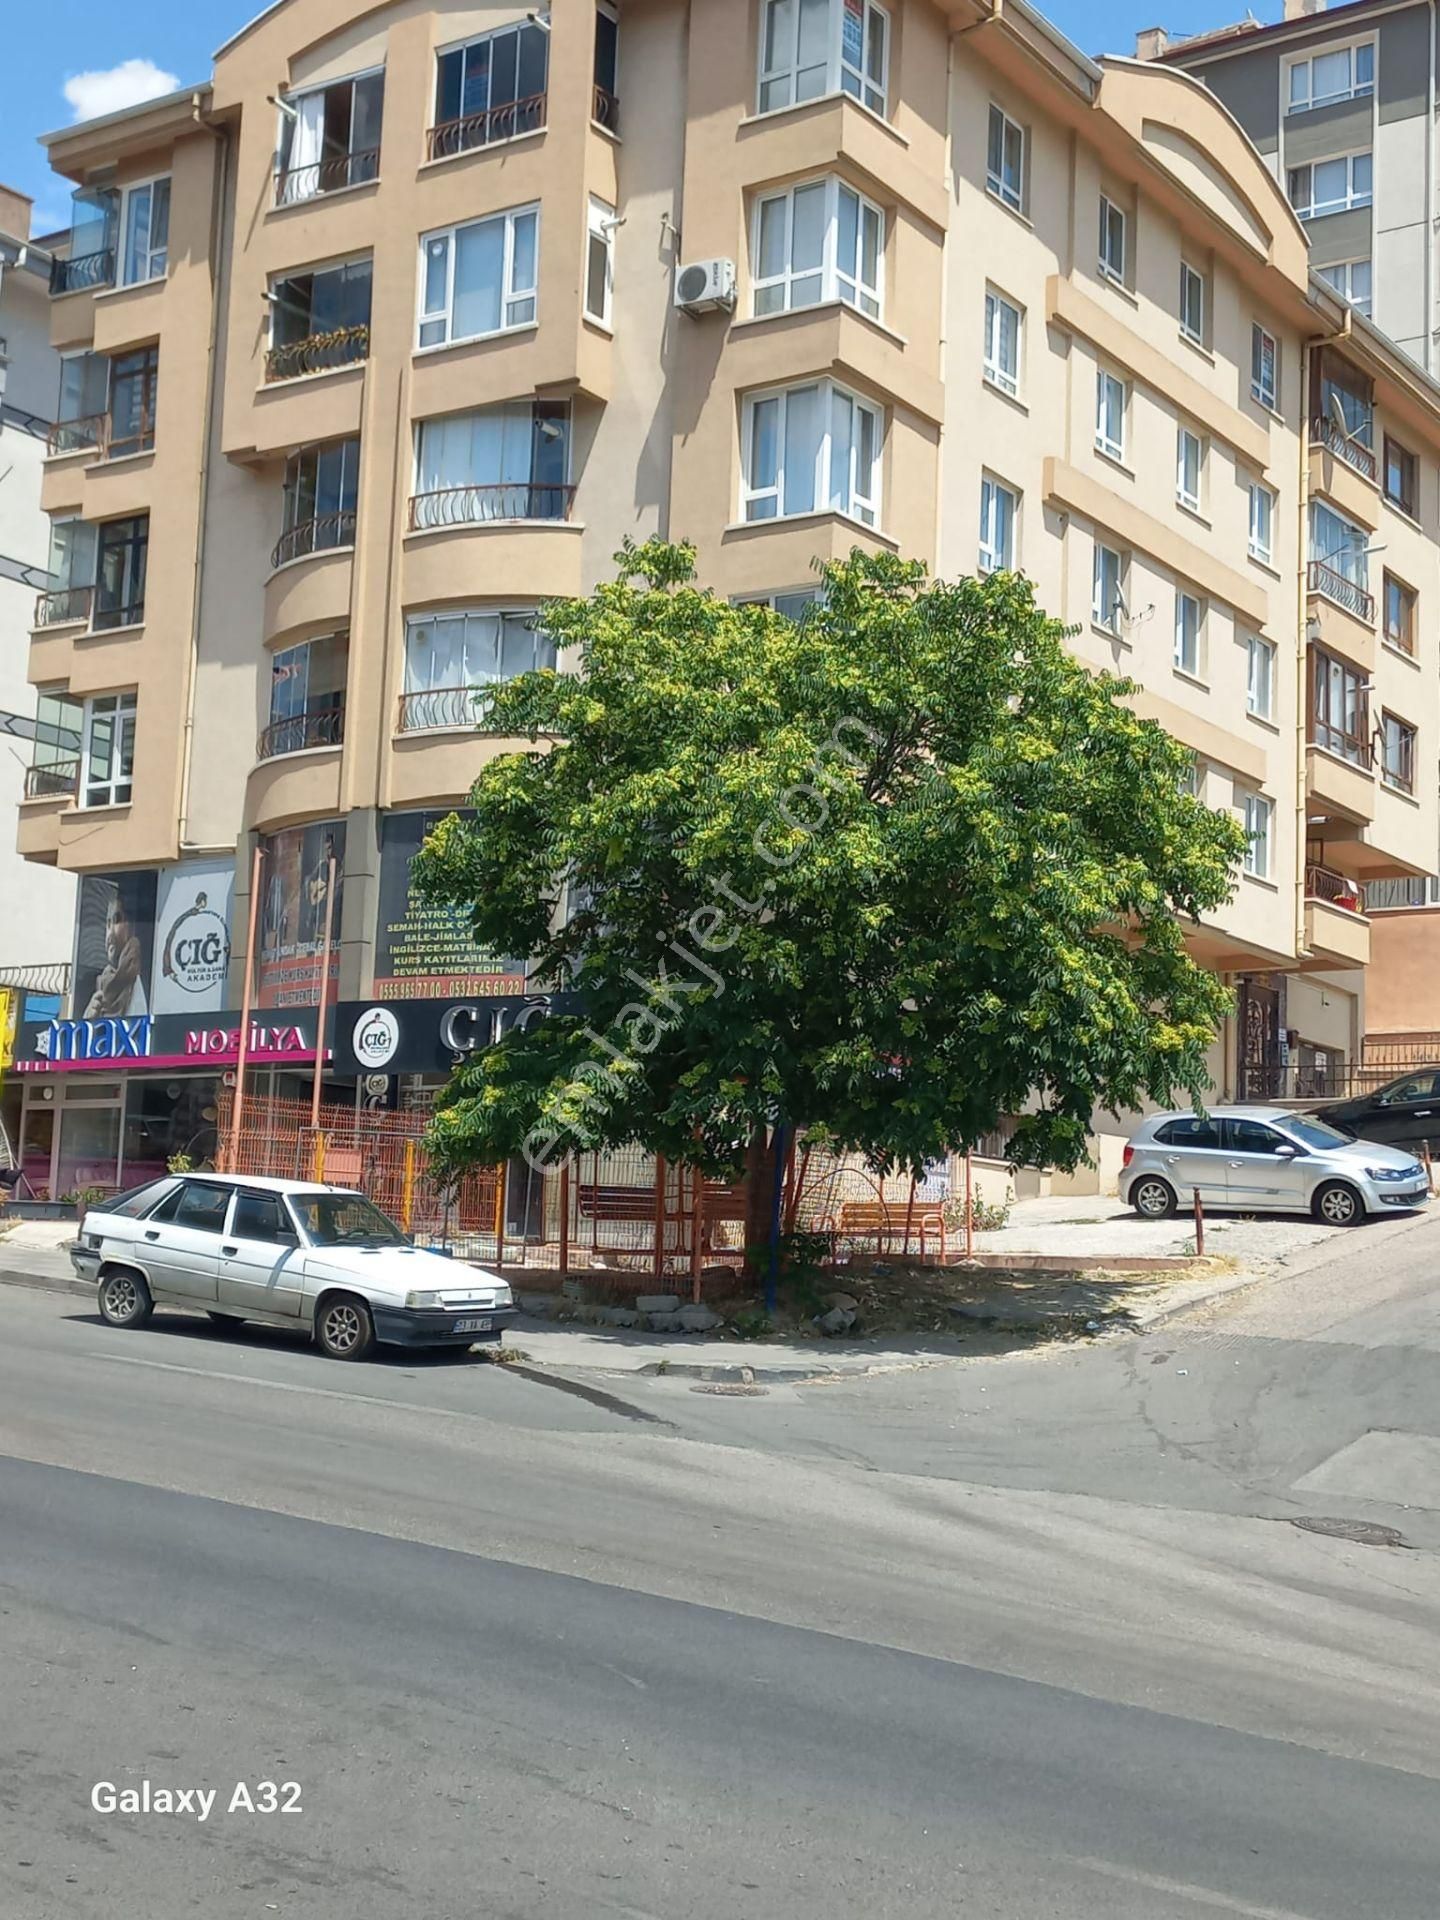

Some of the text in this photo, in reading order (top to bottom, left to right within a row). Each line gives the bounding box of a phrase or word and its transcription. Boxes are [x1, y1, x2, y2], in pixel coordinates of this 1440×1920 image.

[175, 932, 221, 972] ÇIĞ
[393, 956, 421, 965] KURS
[393, 963, 504, 976] DEVAM ETMEKTEDİR
[47, 1014, 154, 1060] maxi
